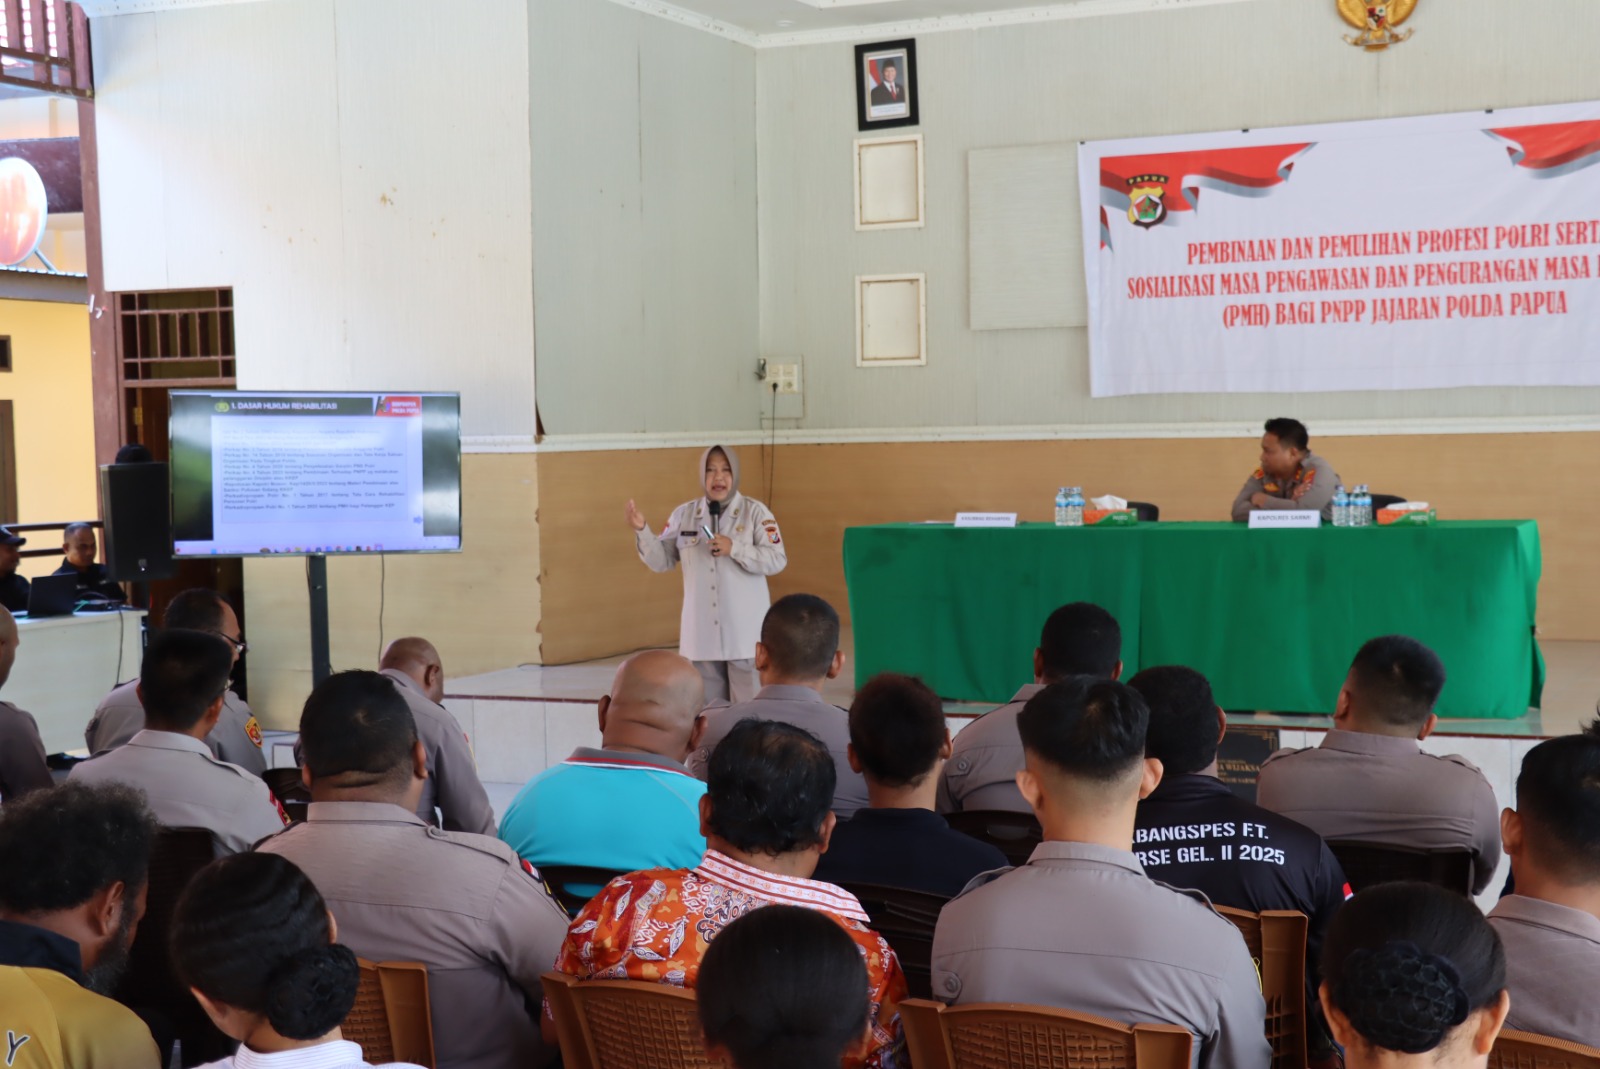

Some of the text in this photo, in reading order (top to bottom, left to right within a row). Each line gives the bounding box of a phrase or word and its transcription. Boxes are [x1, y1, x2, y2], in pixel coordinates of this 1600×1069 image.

[1128, 175, 1166, 184] PAPUA
[1187, 220, 1600, 266] PEMBINAAN DAN PEMULIHAN PROFESI POLRI SERT
[1127, 273, 1216, 300] SOSIALISASI
[1220, 271, 1260, 295] MASA
[1266, 266, 1370, 294] PENGAWASAN
[1375, 264, 1408, 289] DAN
[1414, 258, 1539, 287] PENGURANGAN
[1544, 255, 1591, 281] MASA
[1222, 290, 1568, 330] (PMH) BAGI PNPP JAJARAN POLDA PAPUA
[238, 402, 262, 410] DASAR
[264, 402, 290, 410] HUKUM
[1132, 822, 1236, 844] BANGSPES
[1177, 846, 1214, 863] GEL.
[1222, 845, 1232, 860] II
[1239, 844, 1285, 866] 2025
